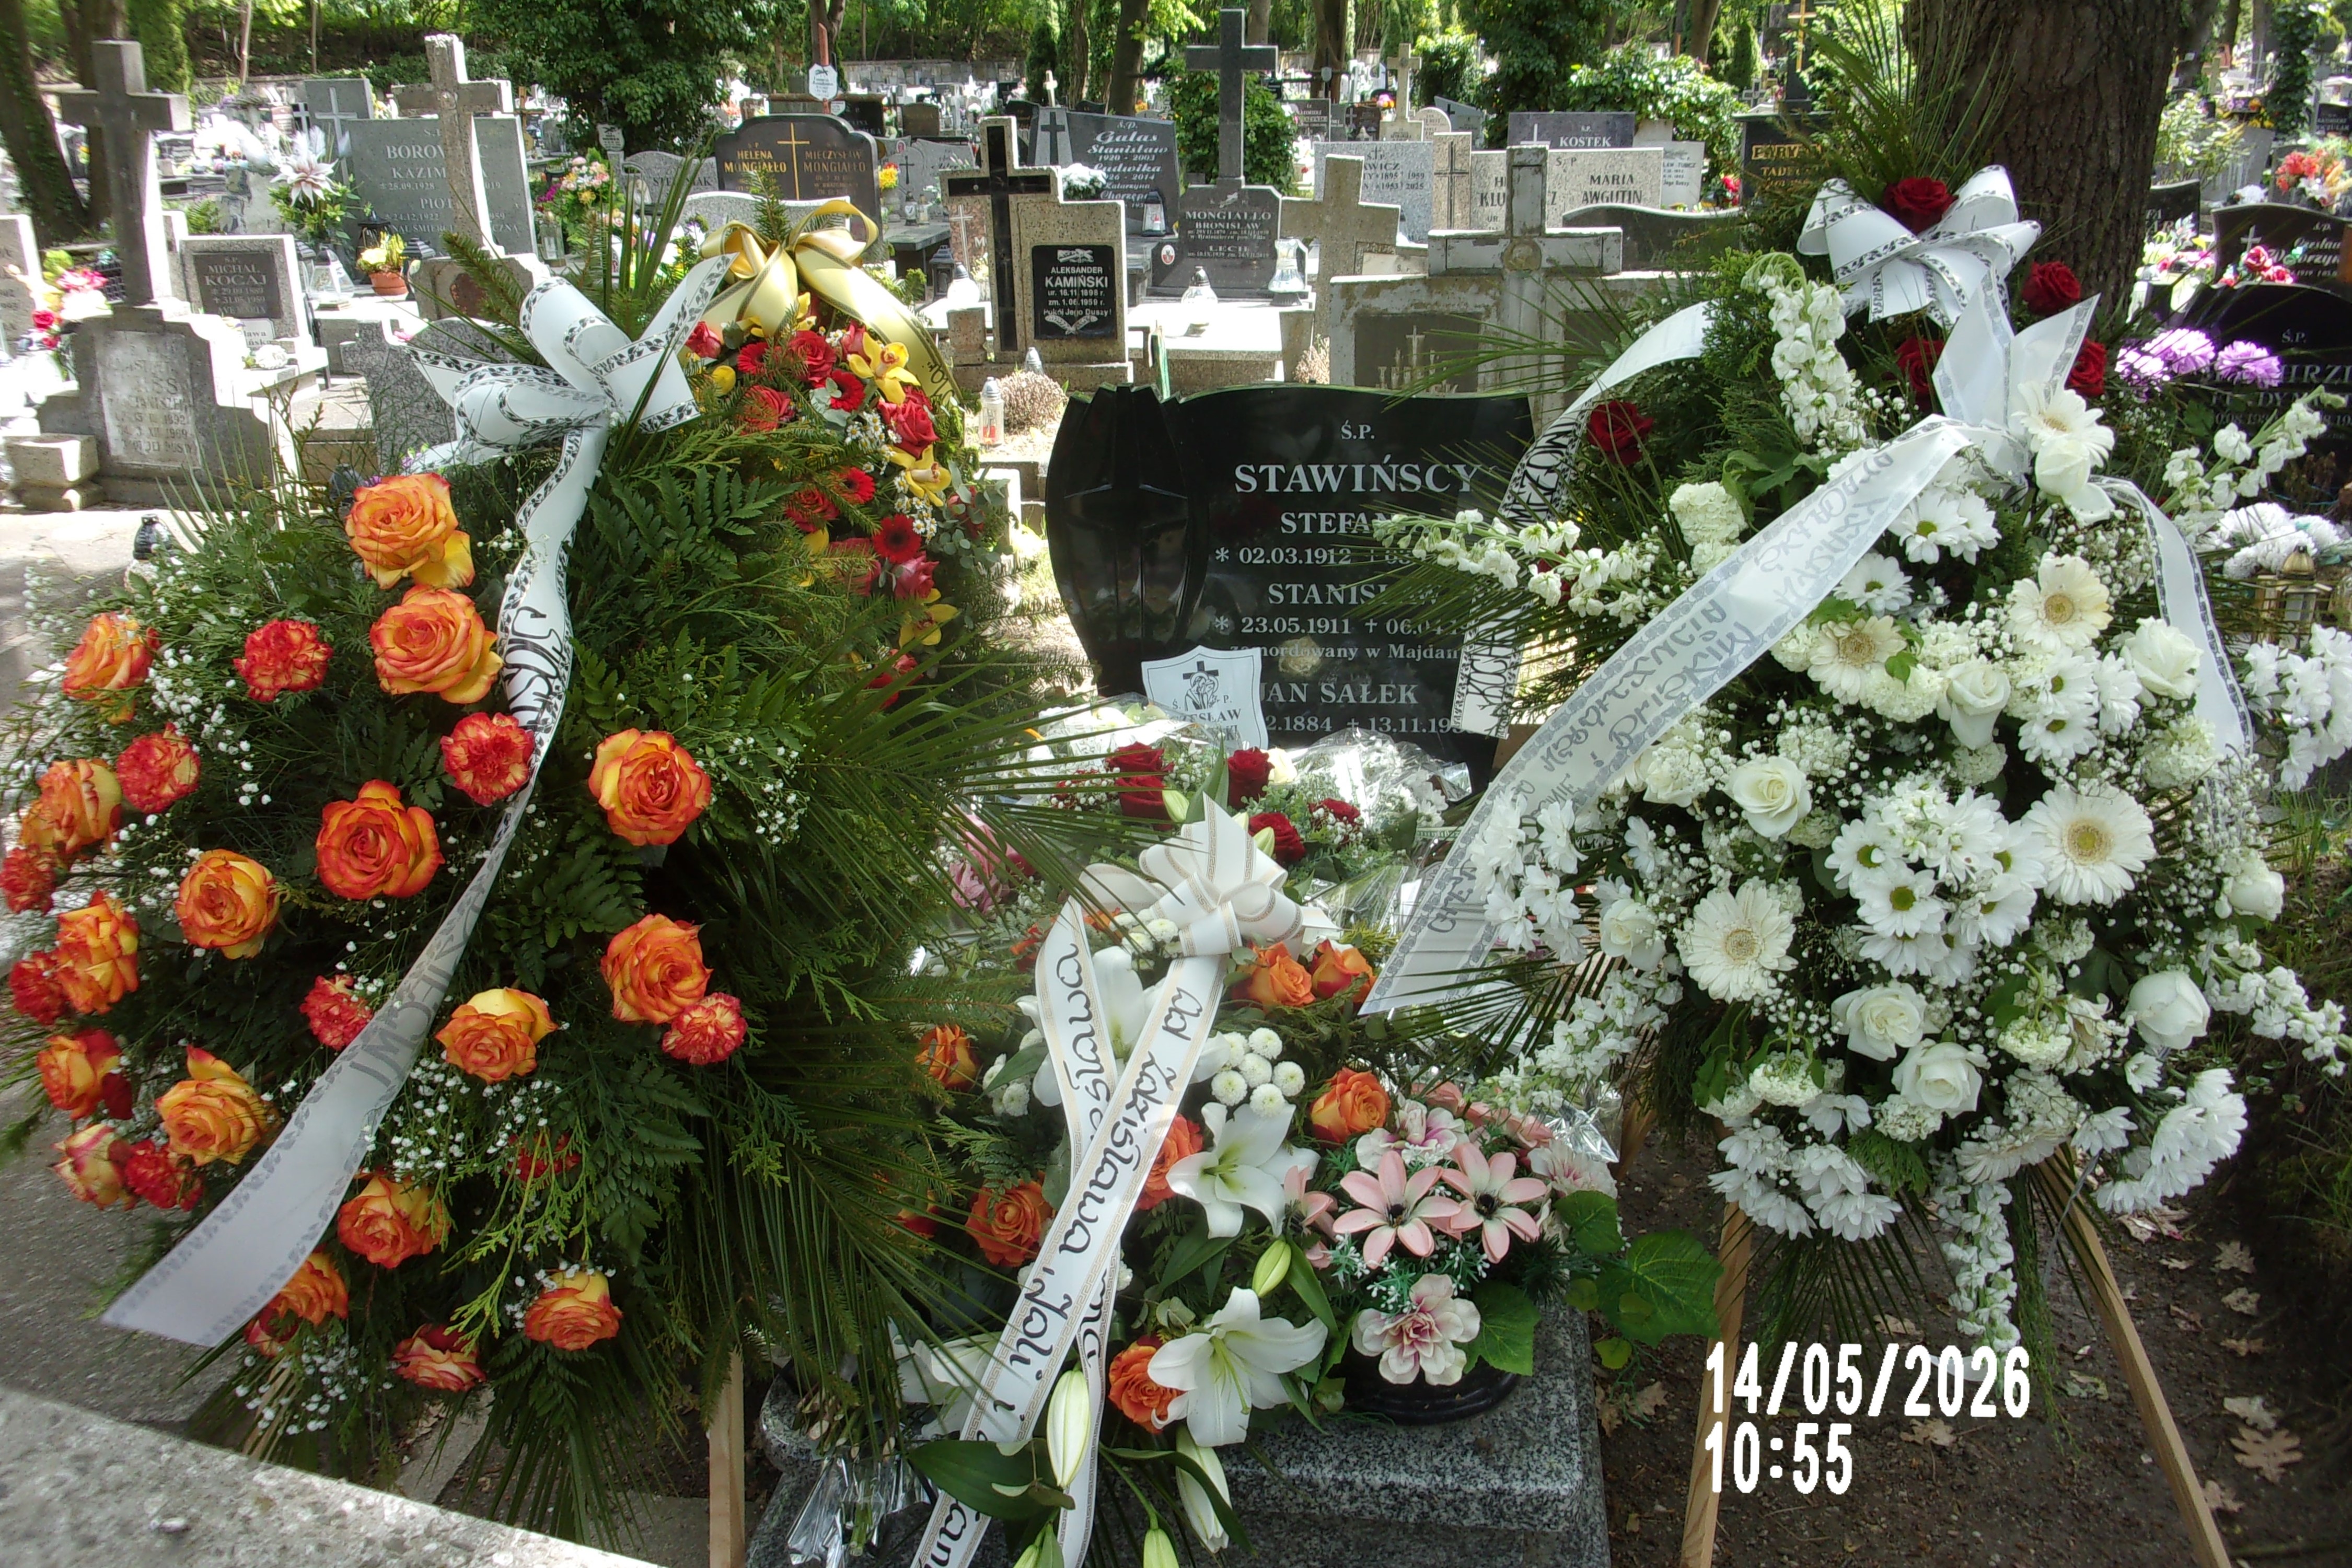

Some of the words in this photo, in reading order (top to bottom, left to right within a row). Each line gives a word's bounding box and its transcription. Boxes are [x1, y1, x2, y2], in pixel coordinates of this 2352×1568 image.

[1559, 135, 1612, 147] KOSTEK
[736, 150, 773, 160] HELENA
[1087, 144, 1169, 154] Stanisław
[724, 161, 787, 173] MONGIAŁŁO
[803, 161, 866, 173] MONGIAŁŁO
[1589, 173, 1635, 186] MARIA
[204, 274, 268, 286] KOCAJ
[1045, 274, 1108, 288] KAMIŃSKI
[1340, 420, 1375, 440] Ś.P.
[1234, 454, 1482, 494] STAWIŃSCY
[1238, 547, 1352, 565] 02.03.1912
[1241, 617, 1352, 635] 23.05.1911
[1366, 647, 1382, 659] w
[1259, 682, 1310, 704] JAN
[1319, 682, 1420, 704] SAŁEK
[1162, 986, 1203, 1042] Od
[1058, 1050, 1177, 1255] Zdzisława
